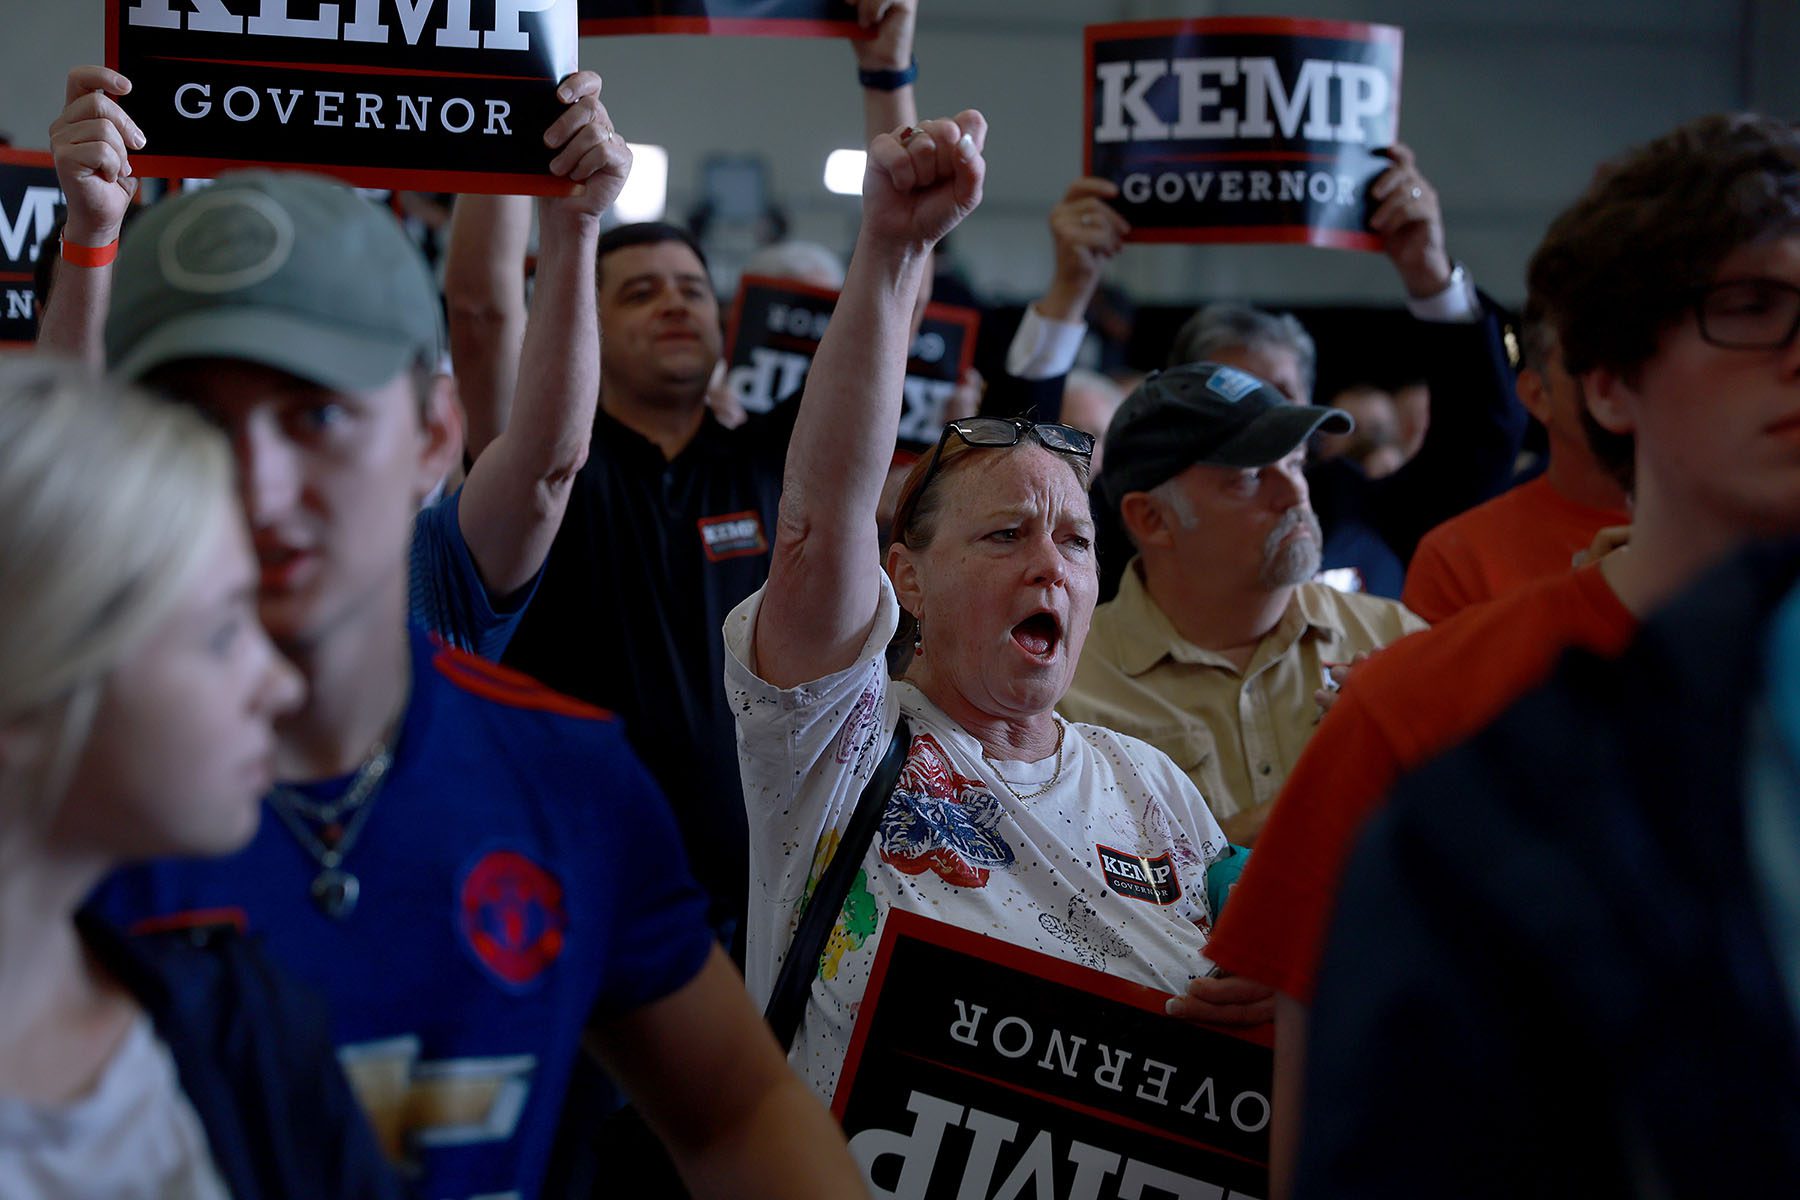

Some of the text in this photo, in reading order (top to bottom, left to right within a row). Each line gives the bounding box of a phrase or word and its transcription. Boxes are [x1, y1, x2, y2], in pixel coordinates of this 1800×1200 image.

[173, 82, 513, 135] GOVERNOR
[1095, 57, 1389, 143] KEMP
[1122, 170, 1356, 205] GOVERNOR
[1101, 854, 1171, 884] KEMP
[949, 999, 1271, 1133] OVERNOR
